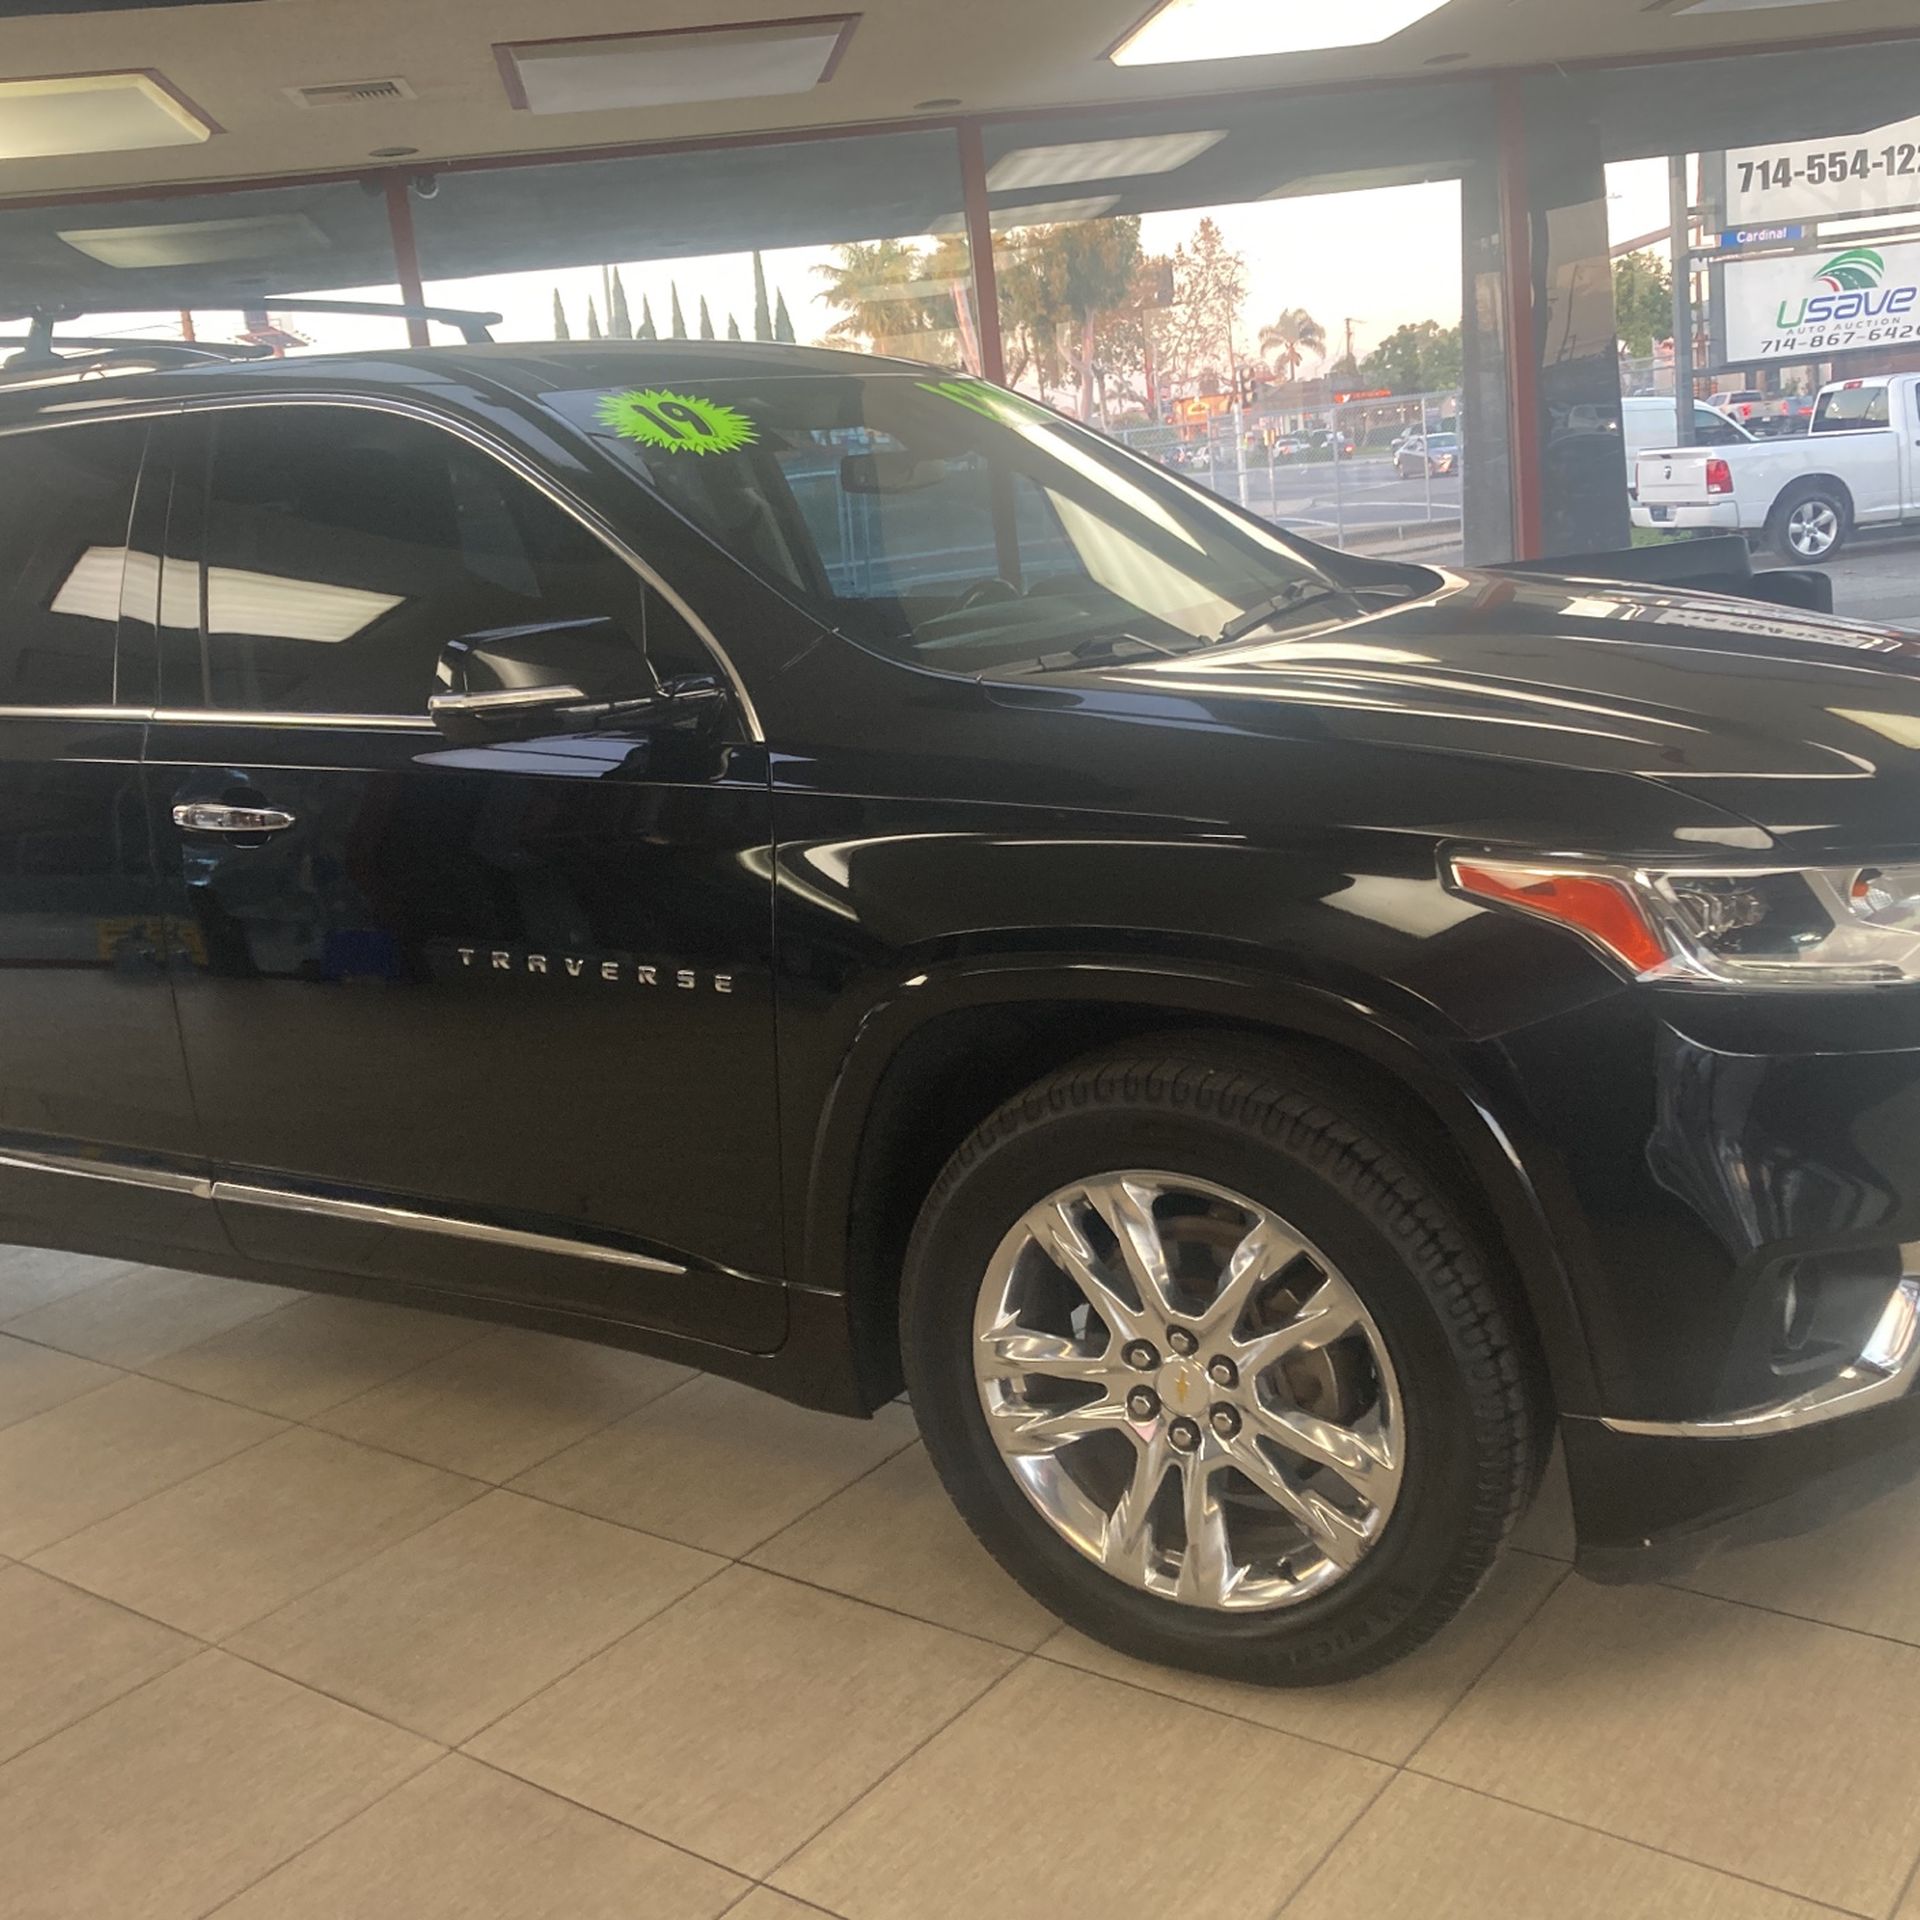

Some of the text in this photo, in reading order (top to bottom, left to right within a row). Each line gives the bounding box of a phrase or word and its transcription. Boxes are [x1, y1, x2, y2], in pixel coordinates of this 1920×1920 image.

[1737, 143, 1920, 192] 714-554-12
[1736, 227, 1788, 243] Cardinal
[1786, 316, 1901, 336] AUTO AUCTION
[630, 401, 715, 440] 19
[457, 947, 733, 993] TRAVERSE
